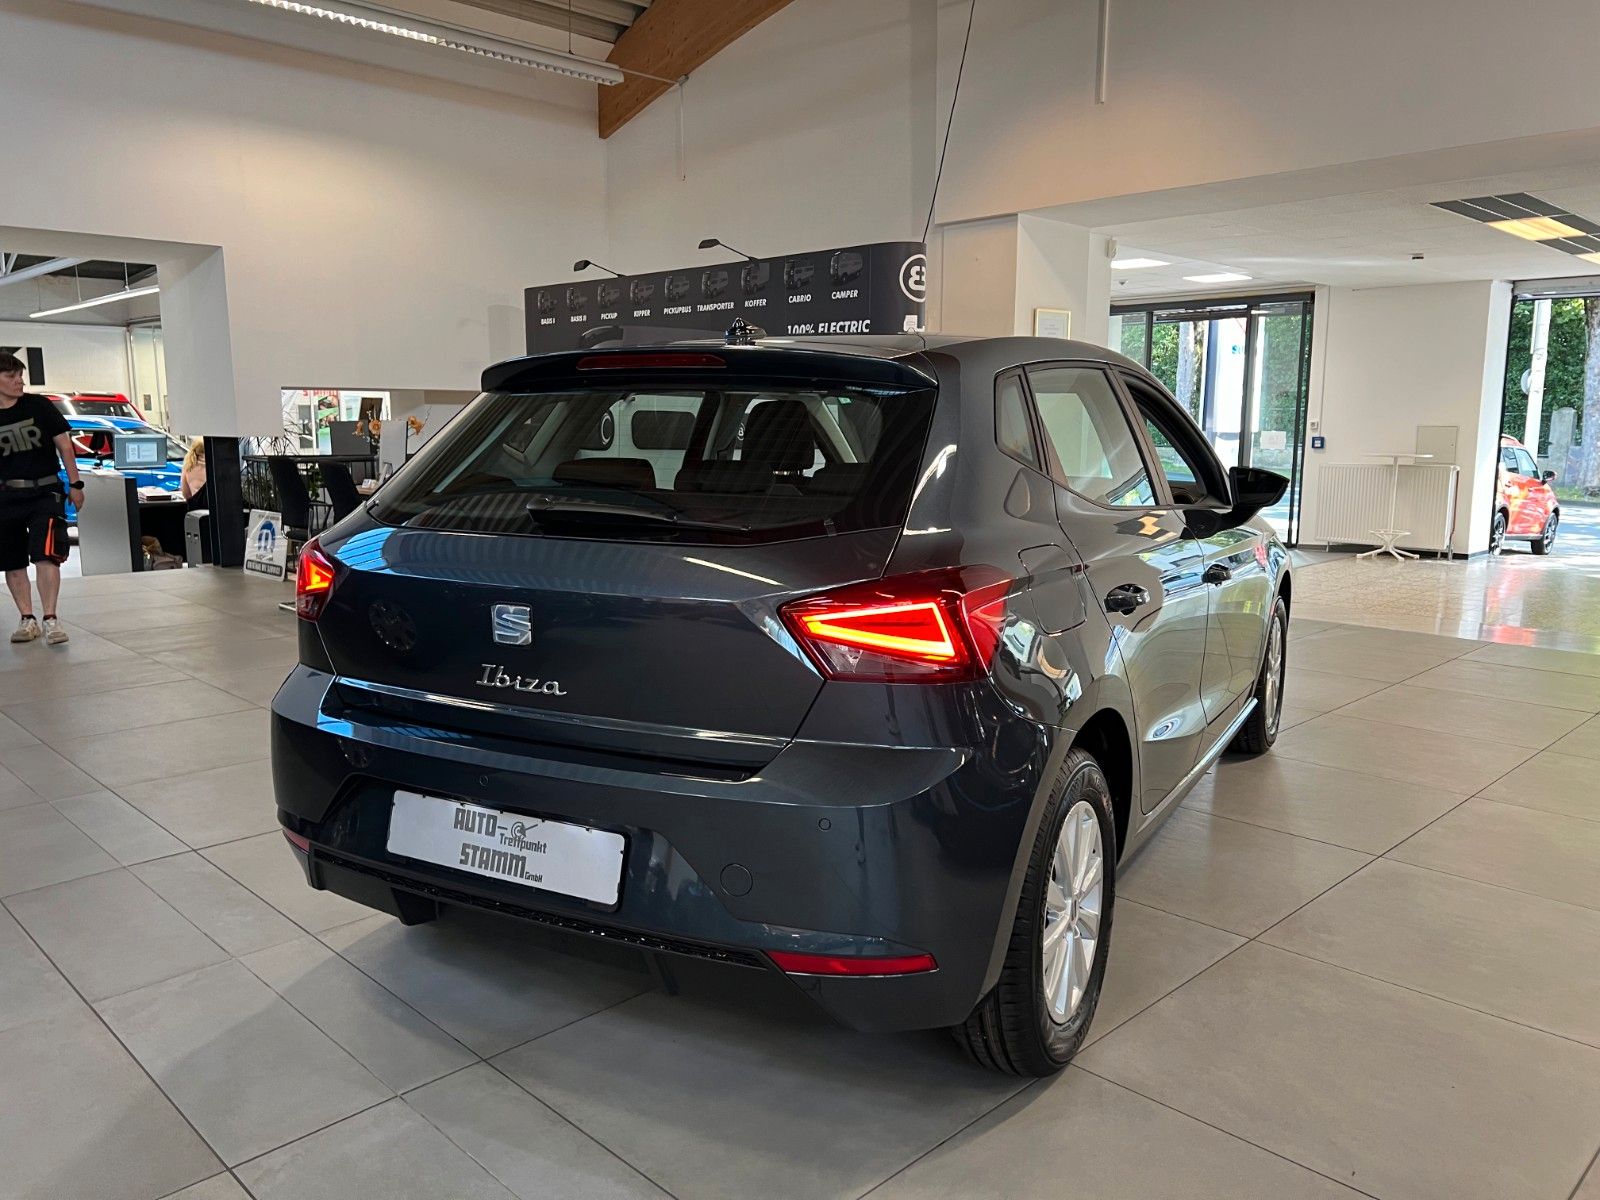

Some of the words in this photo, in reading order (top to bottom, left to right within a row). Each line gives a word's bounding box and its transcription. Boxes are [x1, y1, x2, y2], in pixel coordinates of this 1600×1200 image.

[788, 294, 812, 304] CABRIO
[831, 290, 859, 300] CAMPER
[697, 301, 735, 312] TRANSPORTER
[744, 299, 767, 308] KOFFER
[633, 309, 651, 317] KIPPER
[663, 306, 692, 315] PICKUPBUS
[600, 312, 618, 320] PICKUP
[787, 323, 815, 335] 100%
[476, 663, 568, 696] Ibiza
[459, 842, 527, 879] STAMM
[524, 871, 543, 883] GmbH
